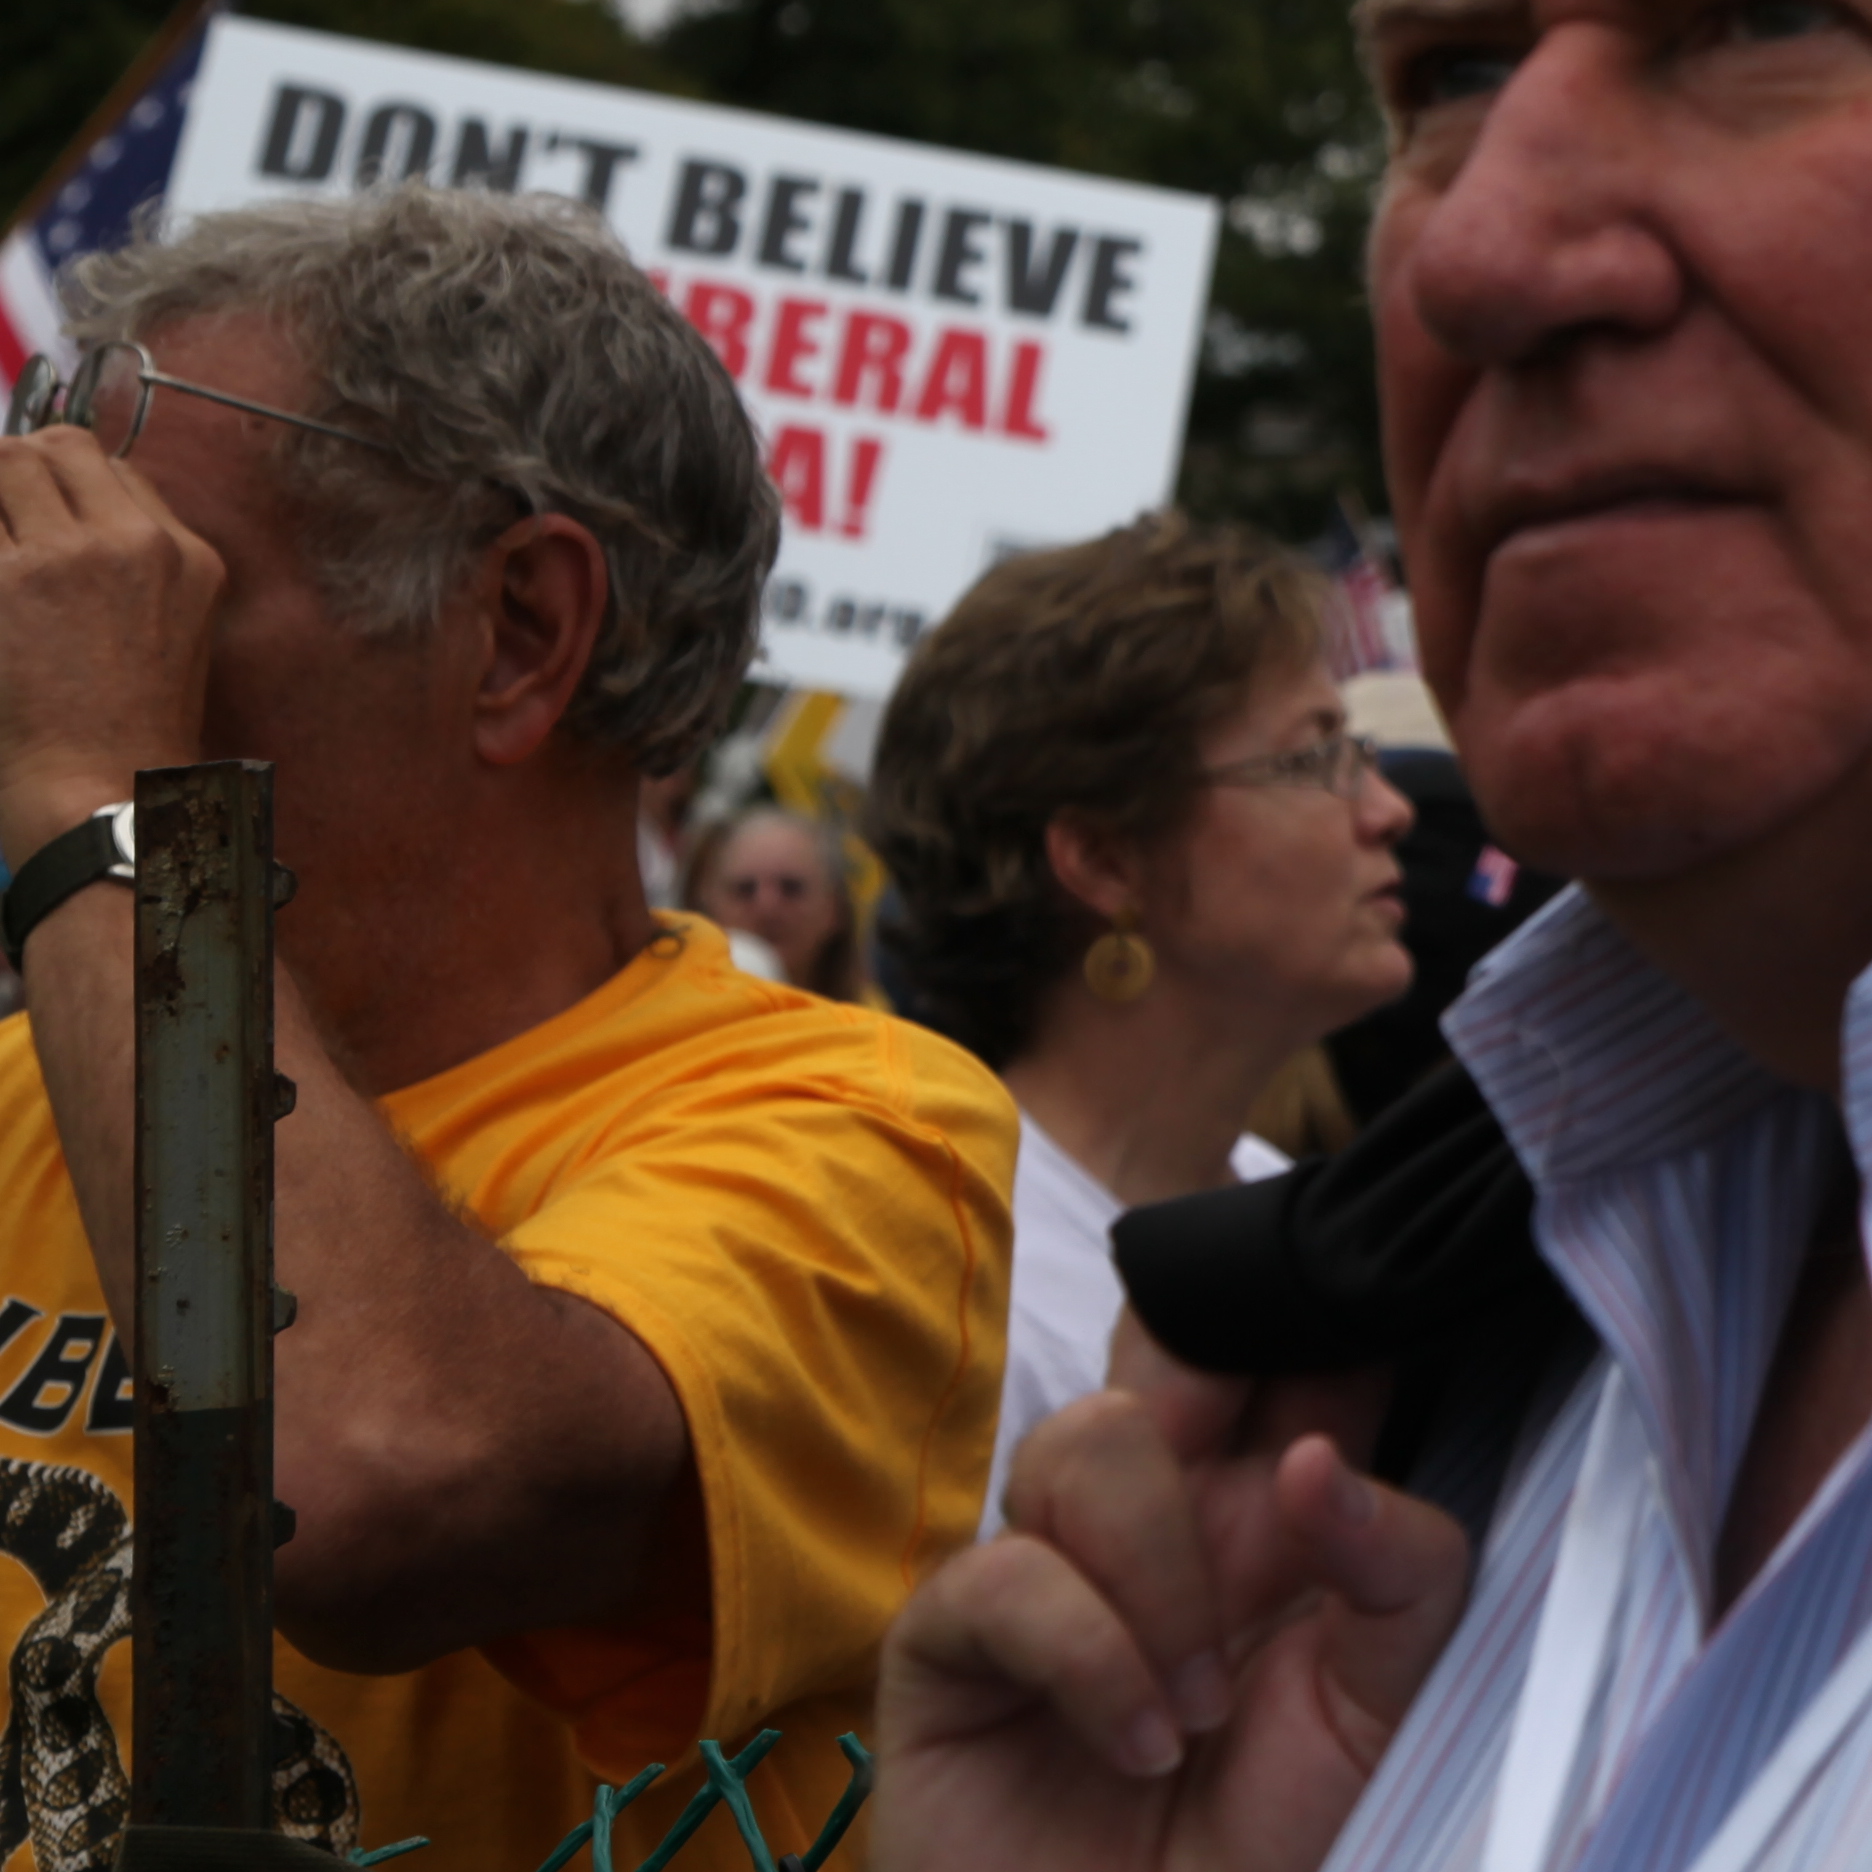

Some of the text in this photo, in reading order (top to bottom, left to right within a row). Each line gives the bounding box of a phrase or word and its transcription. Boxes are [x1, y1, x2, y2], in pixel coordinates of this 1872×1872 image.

[252, 79, 1146, 336] DON'T BELIEVE
[646, 270, 1050, 445] BERAL
